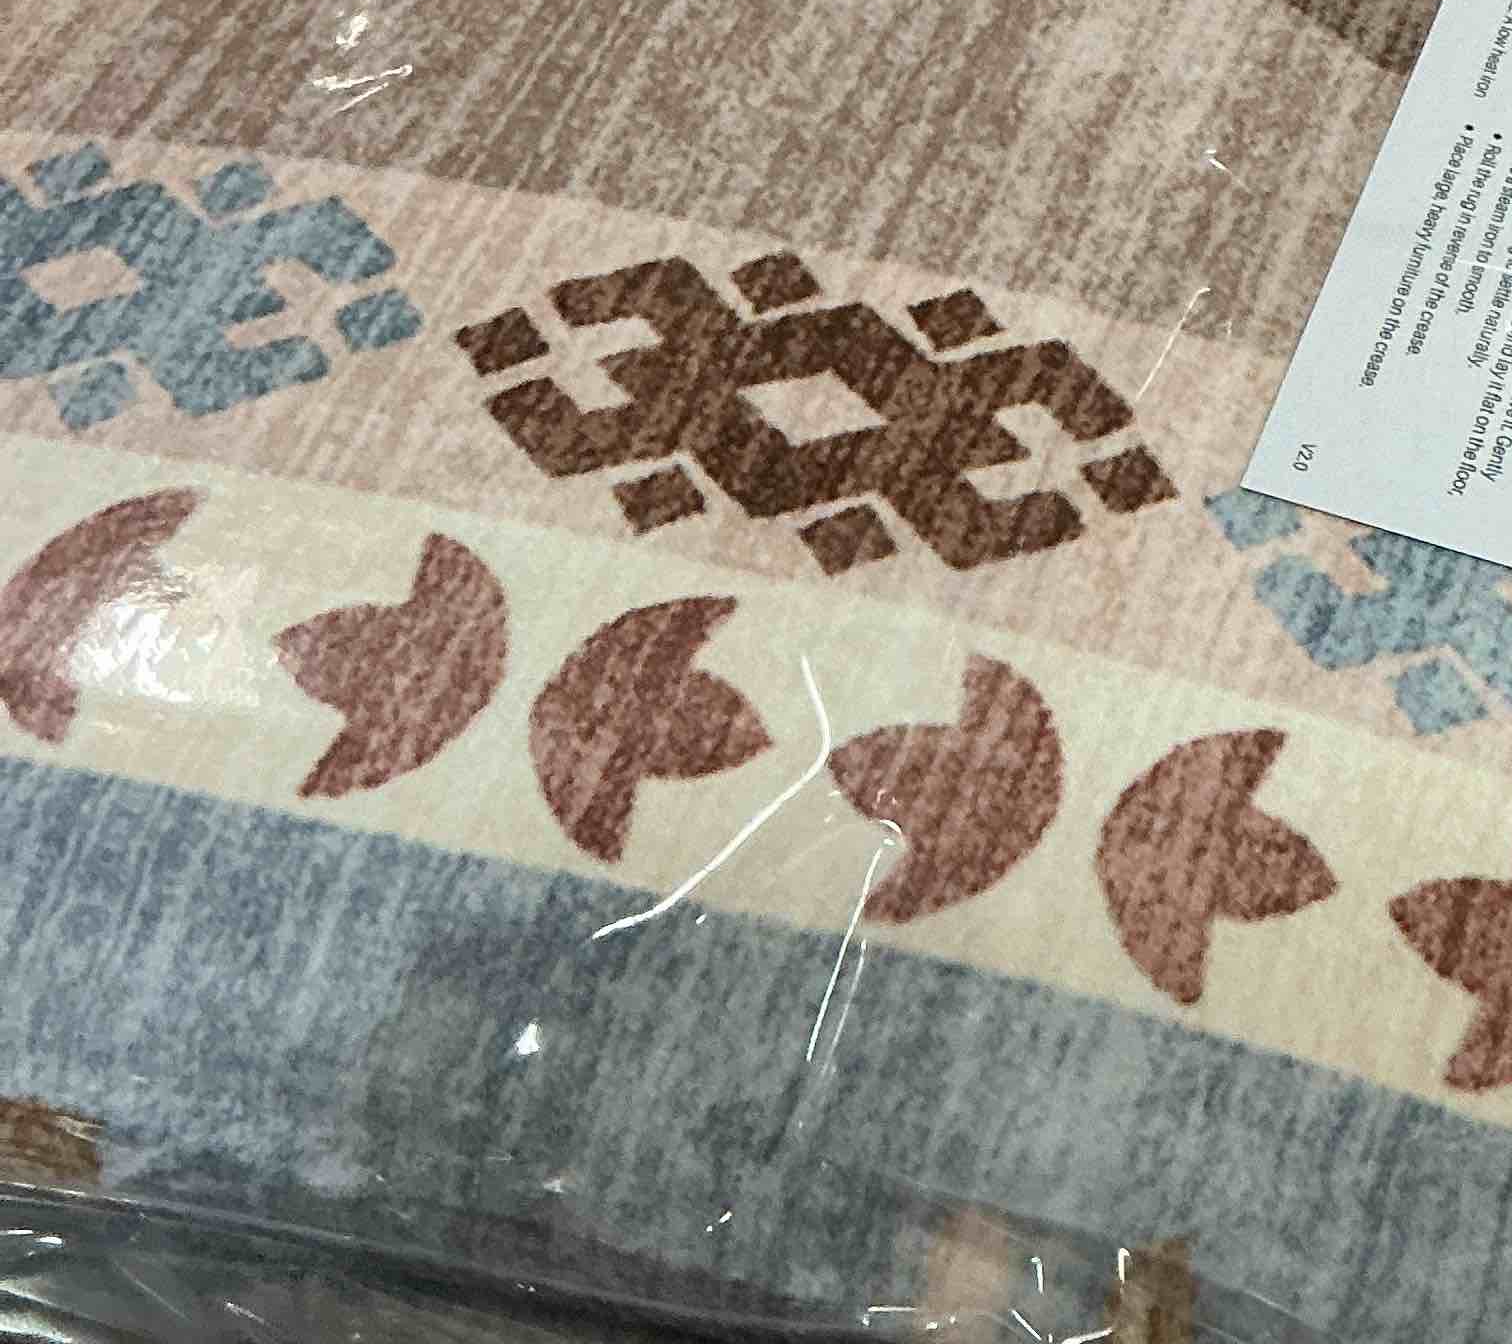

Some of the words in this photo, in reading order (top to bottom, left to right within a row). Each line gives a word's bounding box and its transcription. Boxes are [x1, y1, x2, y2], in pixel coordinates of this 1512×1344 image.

[1482, 46, 1506, 76] heat
[1472, 73, 1495, 100] iron
[1446, 132, 1475, 171] Place
[1478, 141, 1503, 170] Roll
[1428, 165, 1461, 206] large,
[1470, 165, 1494, 191] the
[1457, 185, 1483, 213] rug
[1412, 199, 1447, 244] heavy
[1456, 210, 1477, 228] in
[1438, 223, 1469, 273] reverse
[1478, 221, 1504, 252] iron
[1394, 239, 1432, 300] furniture
[1473, 247, 1494, 267] to
[1432, 269, 1454, 289] of
[1453, 262, 1489, 320] smooth.
[1386, 295, 1407, 318] on
[1423, 285, 1448, 313] the
[1377, 315, 1402, 343] the
[1404, 308, 1436, 360] crease.
[1463, 306, 1505, 374] naturally.
[1357, 339, 1390, 392] crease.
[1487, 378, 1506, 393] it
[1478, 389, 1503, 417] flat
[1471, 413, 1490, 436] on
[1290, 438, 1319, 474] V2.0
[1461, 434, 1487, 464] the
[1444, 458, 1477, 501] floor,
